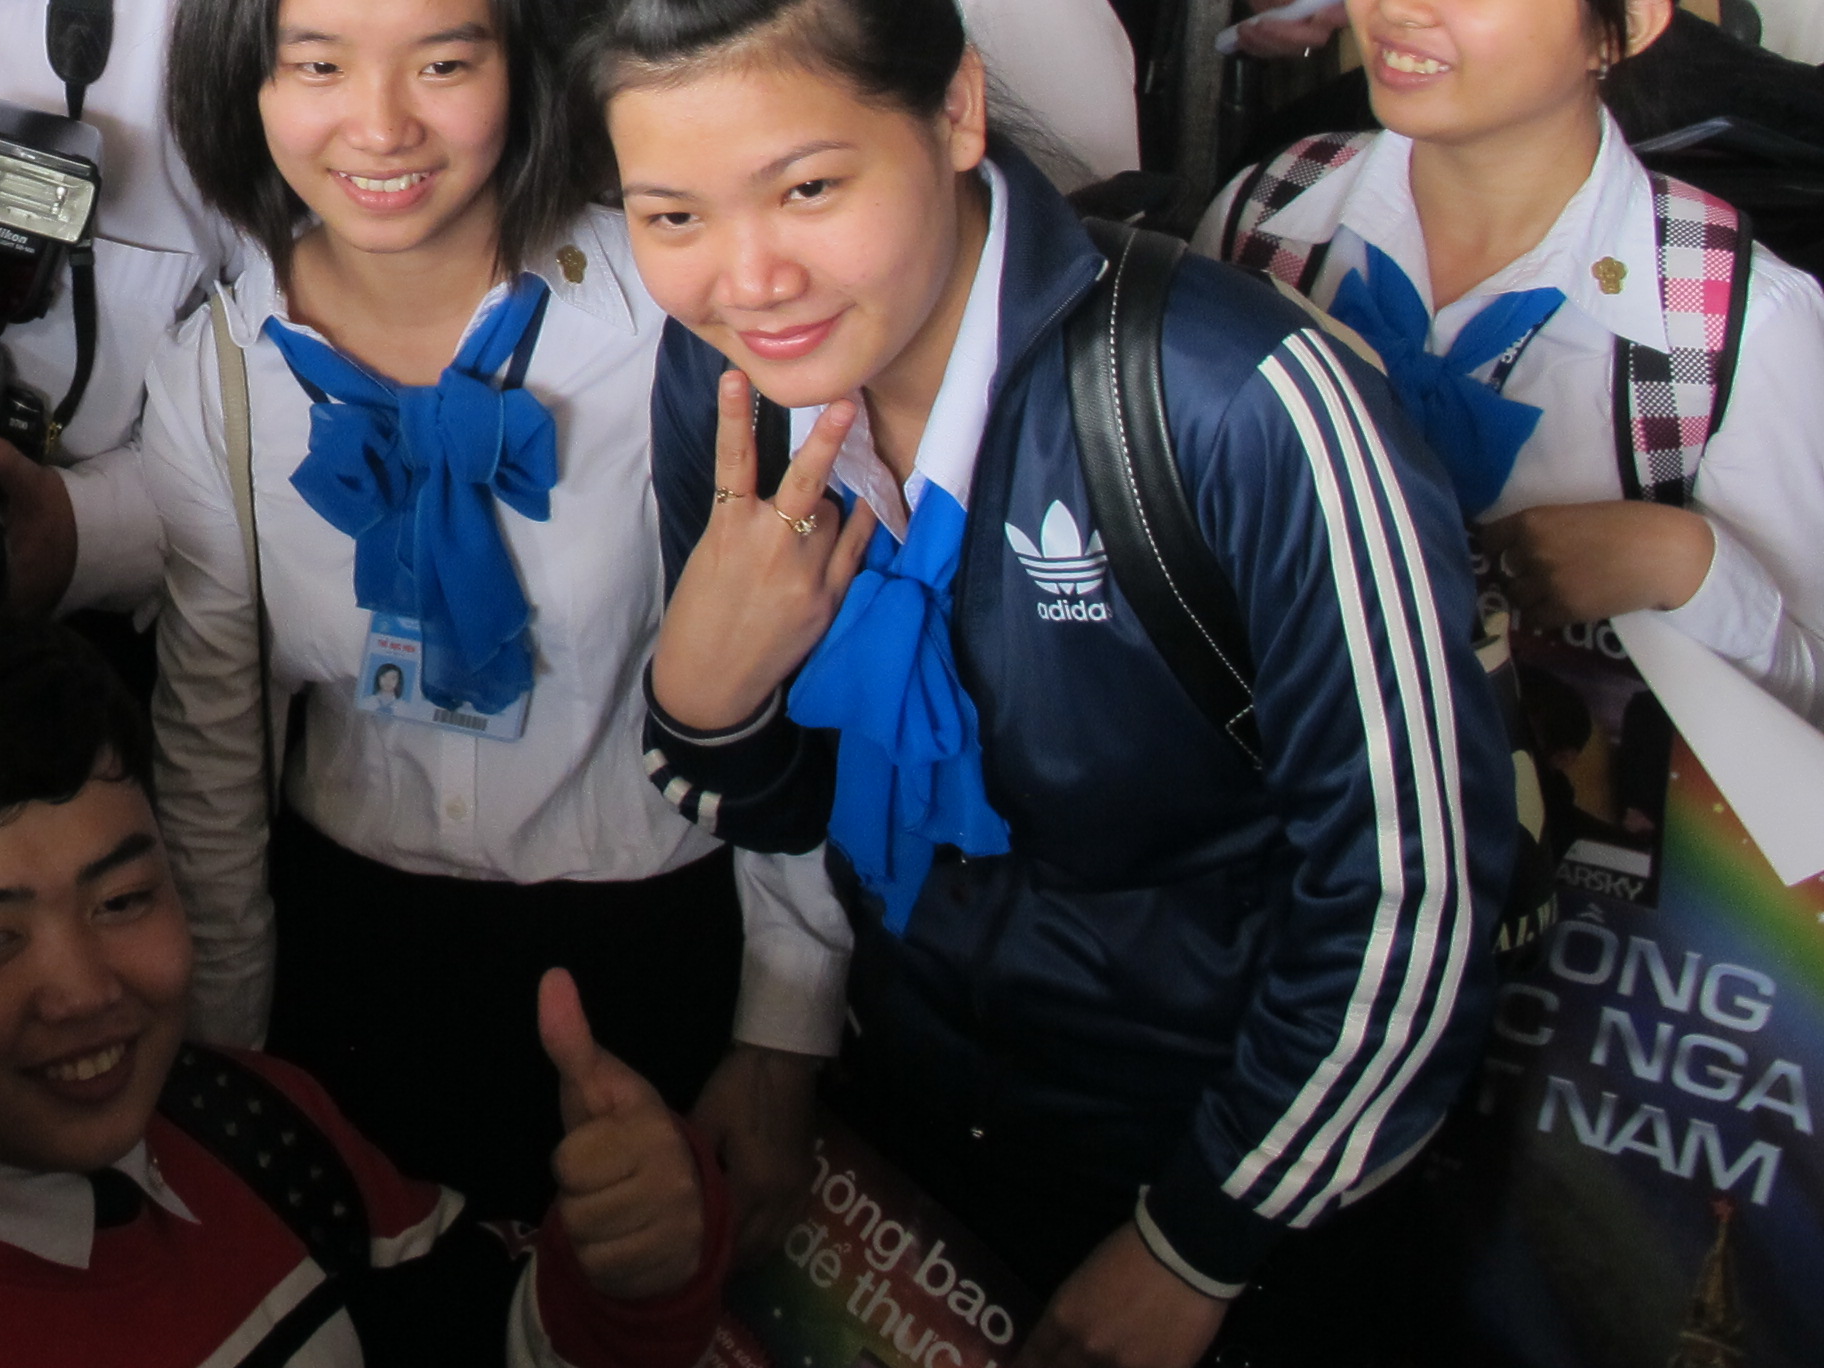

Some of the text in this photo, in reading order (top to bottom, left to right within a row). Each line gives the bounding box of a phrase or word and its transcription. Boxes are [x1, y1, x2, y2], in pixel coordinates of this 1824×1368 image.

[1548, 903, 1777, 1033] ỒNG
[1590, 1005, 1813, 1136] NGA
[1537, 1074, 1783, 1207] NAM
[783, 1217, 853, 1289] để
[913, 1238, 1015, 1346] bao
